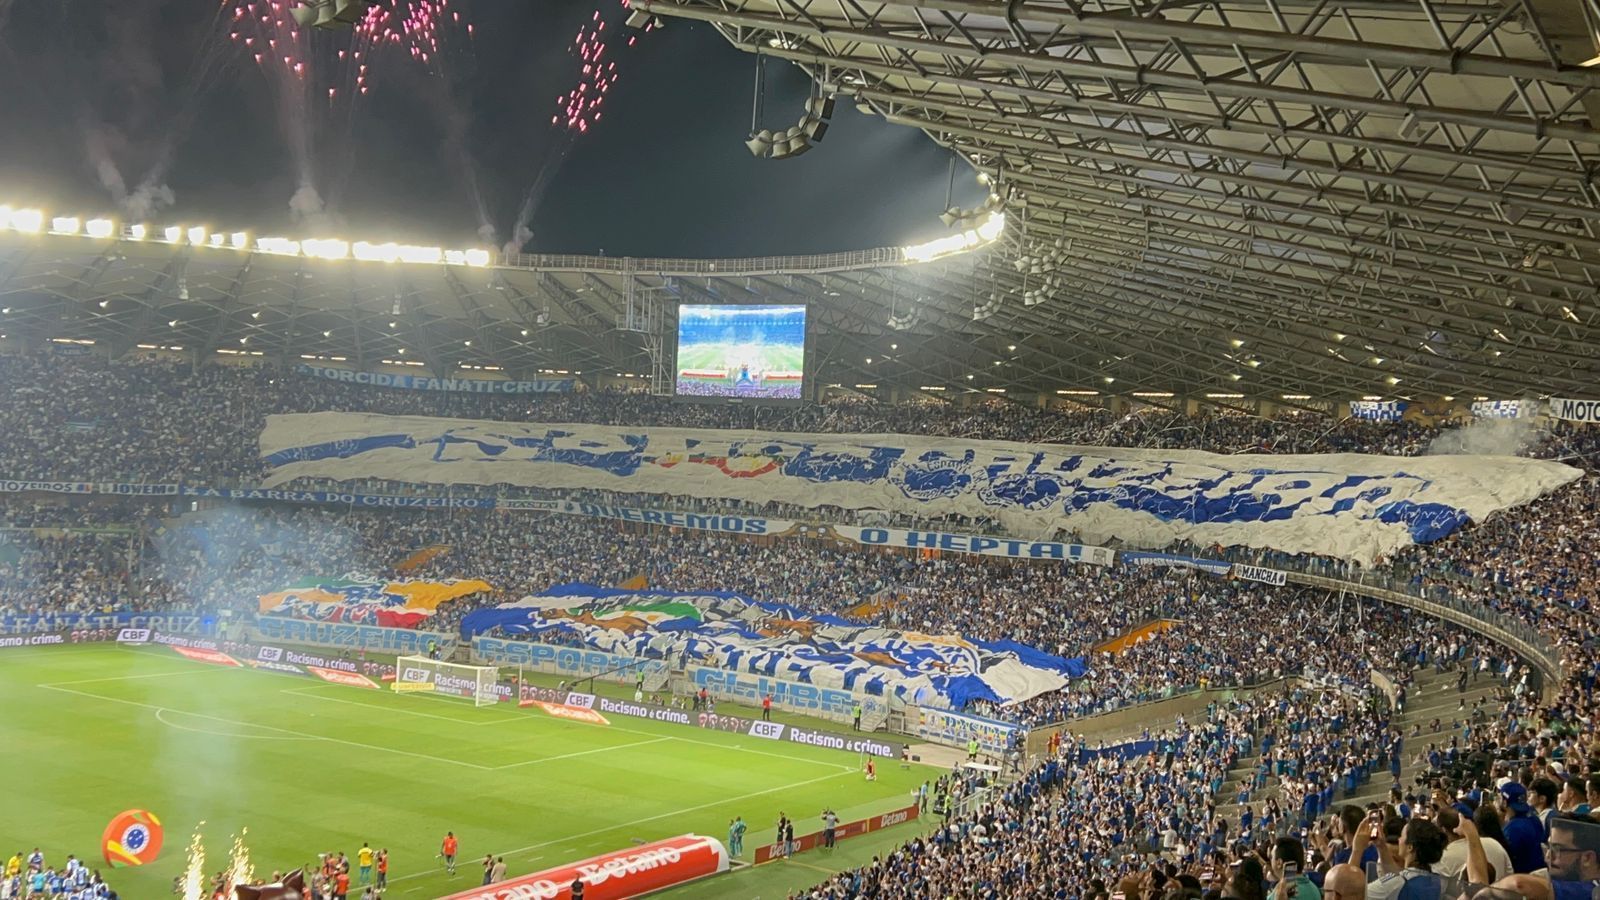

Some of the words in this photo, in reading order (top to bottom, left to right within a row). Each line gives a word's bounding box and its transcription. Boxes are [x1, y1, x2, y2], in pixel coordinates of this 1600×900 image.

[312, 366, 408, 388] TORCIDA
[412, 375, 563, 394] FANATI-CRUZ
[113, 483, 166, 494] JOVEM
[205, 488, 220, 497] A
[230, 488, 316, 502] BARRA
[326, 492, 355, 503] DO
[363, 495, 478, 508] CRUZEIRO
[581, 502, 767, 535] QUEREMOS
[860, 528, 889, 544] O
[905, 531, 1083, 562] HEPTA!
[1242, 565, 1279, 584] MANCHA
[15, 614, 200, 634] FANATI-CRUZ
[32, 633, 64, 646] crime.
[122, 630, 146, 640] CBF
[154, 632, 188, 647] Racismo
[194, 636, 218, 650] crime.
[261, 648, 280, 660] CBF
[286, 651, 325, 669] Racismo
[331, 658, 358, 672] crime.
[406, 669, 425, 679] CBF
[434, 673, 476, 690] Racismo
[484, 681, 514, 697] crime.
[694, 666, 853, 715] CLUBE
[569, 694, 590, 707] CBF
[600, 698, 647, 718] Racismo
[655, 707, 690, 724] crime.
[754, 723, 778, 736] CBF
[790, 728, 844, 749] Racismo
[854, 737, 894, 758] crime.
[576, 846, 682, 886] Betano
